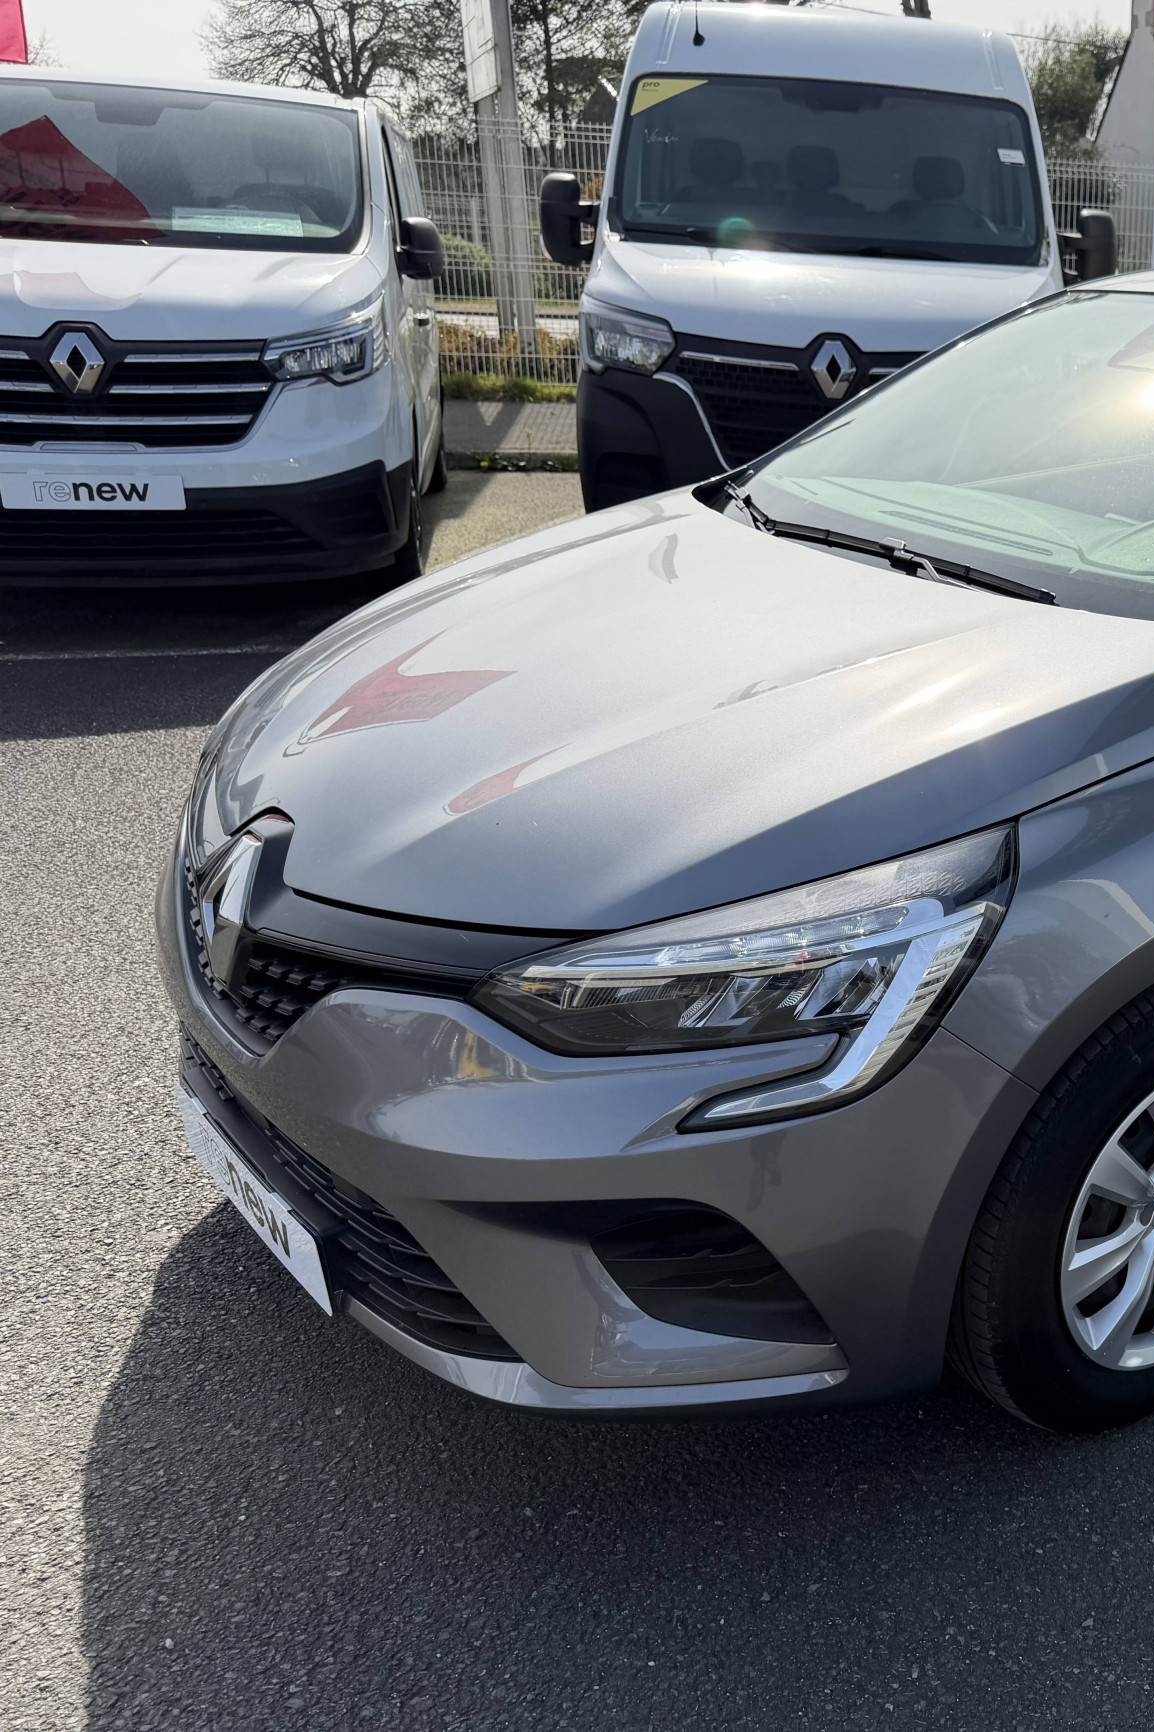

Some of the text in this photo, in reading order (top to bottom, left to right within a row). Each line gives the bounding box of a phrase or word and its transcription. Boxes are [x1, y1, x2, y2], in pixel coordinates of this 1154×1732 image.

[641, 81, 661, 89] pro
[33, 480, 149, 502] renew
[198, 1121, 292, 1260] renew
